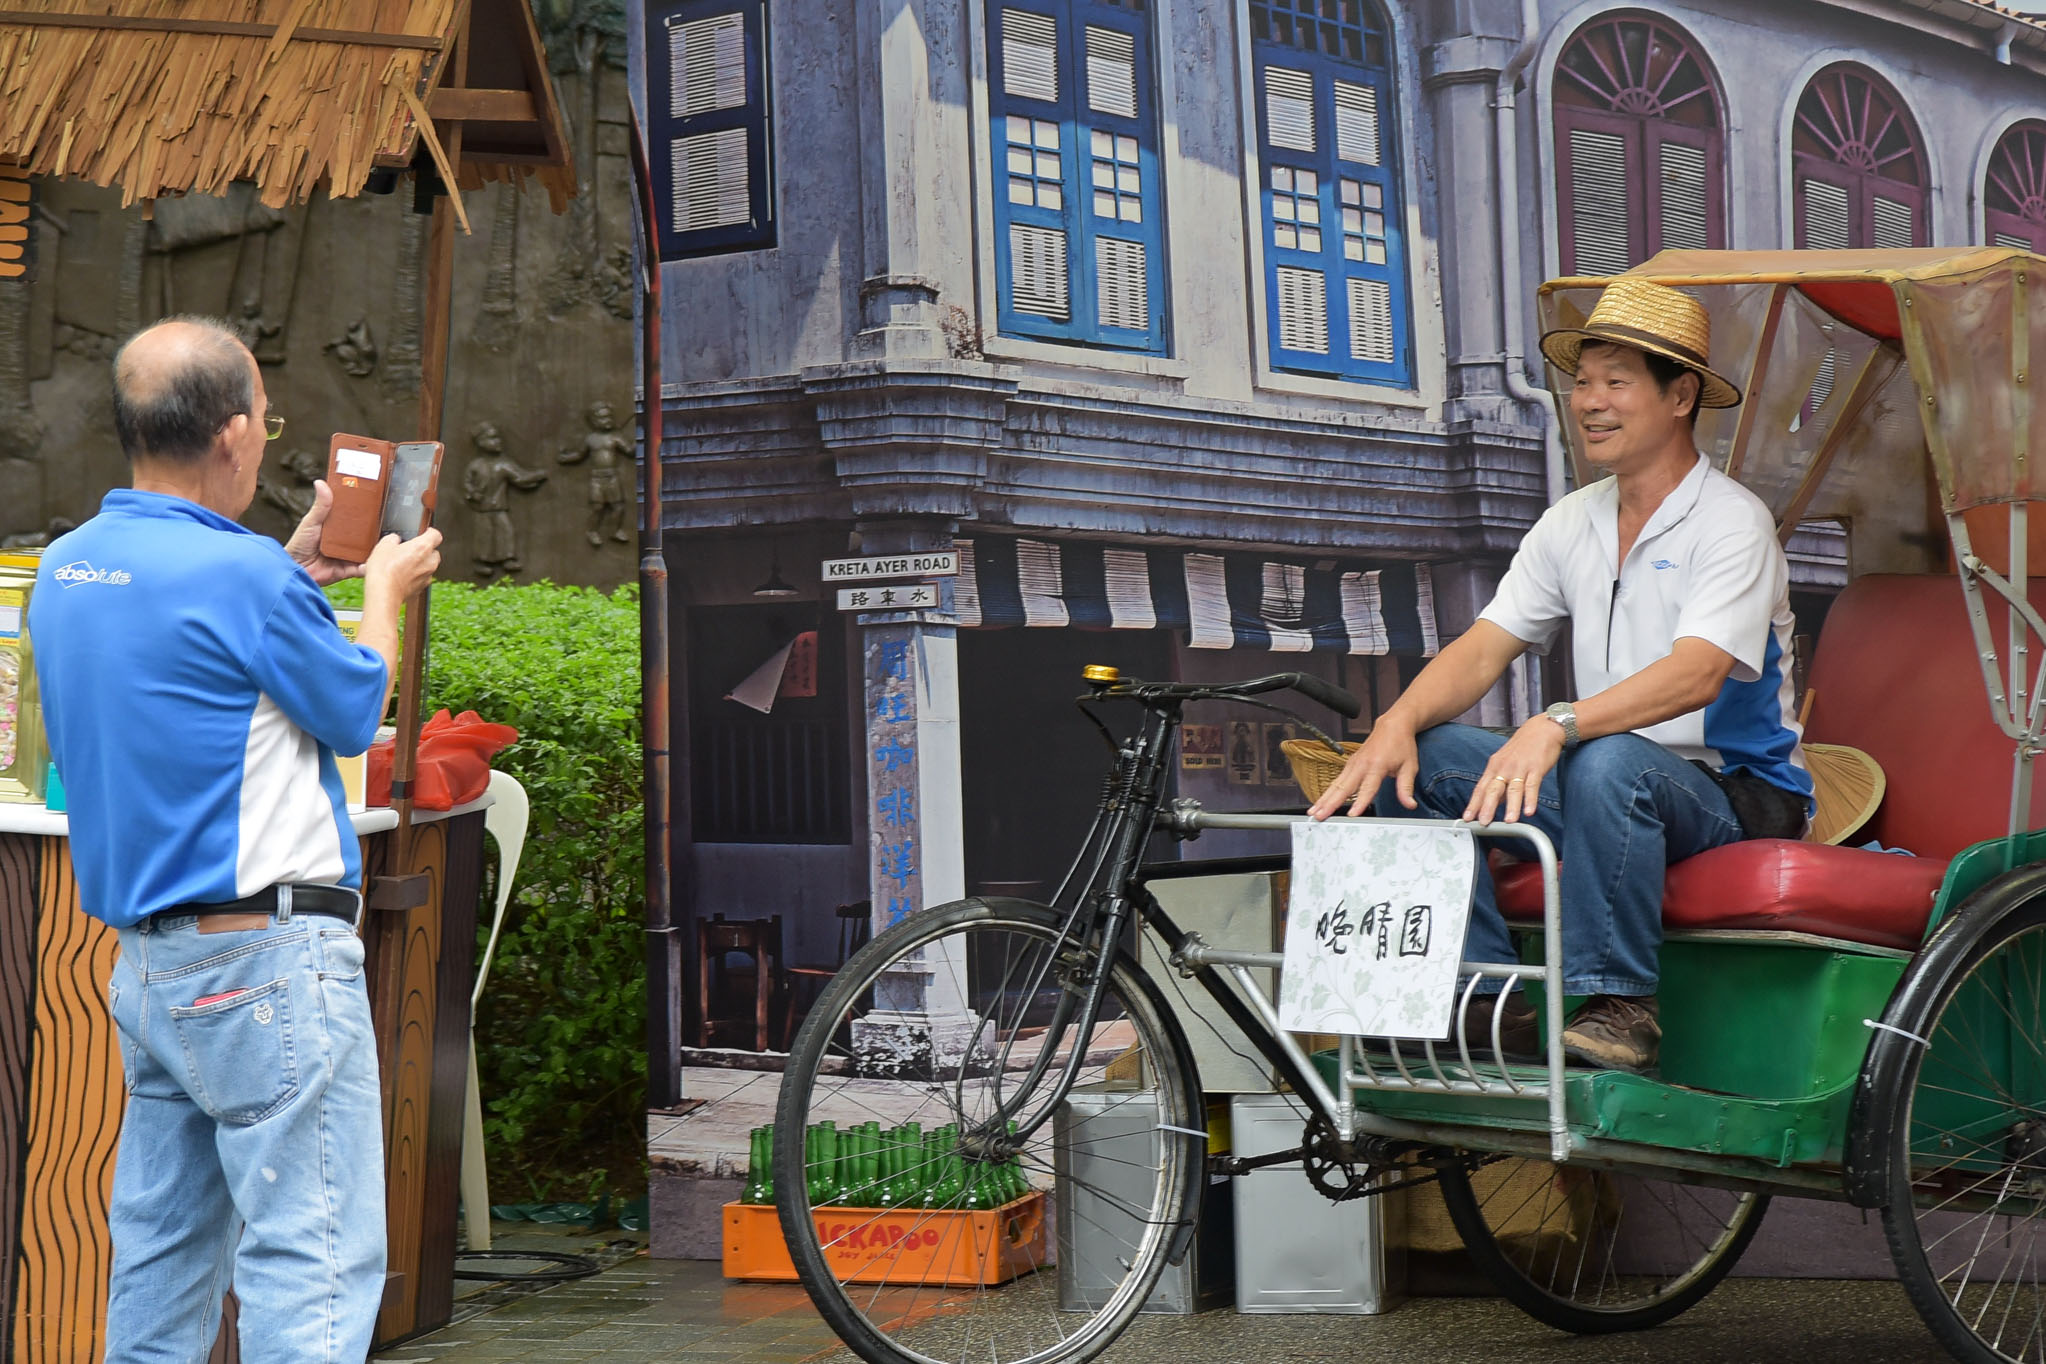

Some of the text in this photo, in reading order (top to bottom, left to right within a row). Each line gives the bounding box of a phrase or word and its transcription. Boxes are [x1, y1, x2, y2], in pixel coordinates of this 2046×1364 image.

[55, 565, 132, 585] absolute
[829, 557, 951, 576] KRETA AYER ROAD
[818, 1221, 940, 1251] ICKAPOO
